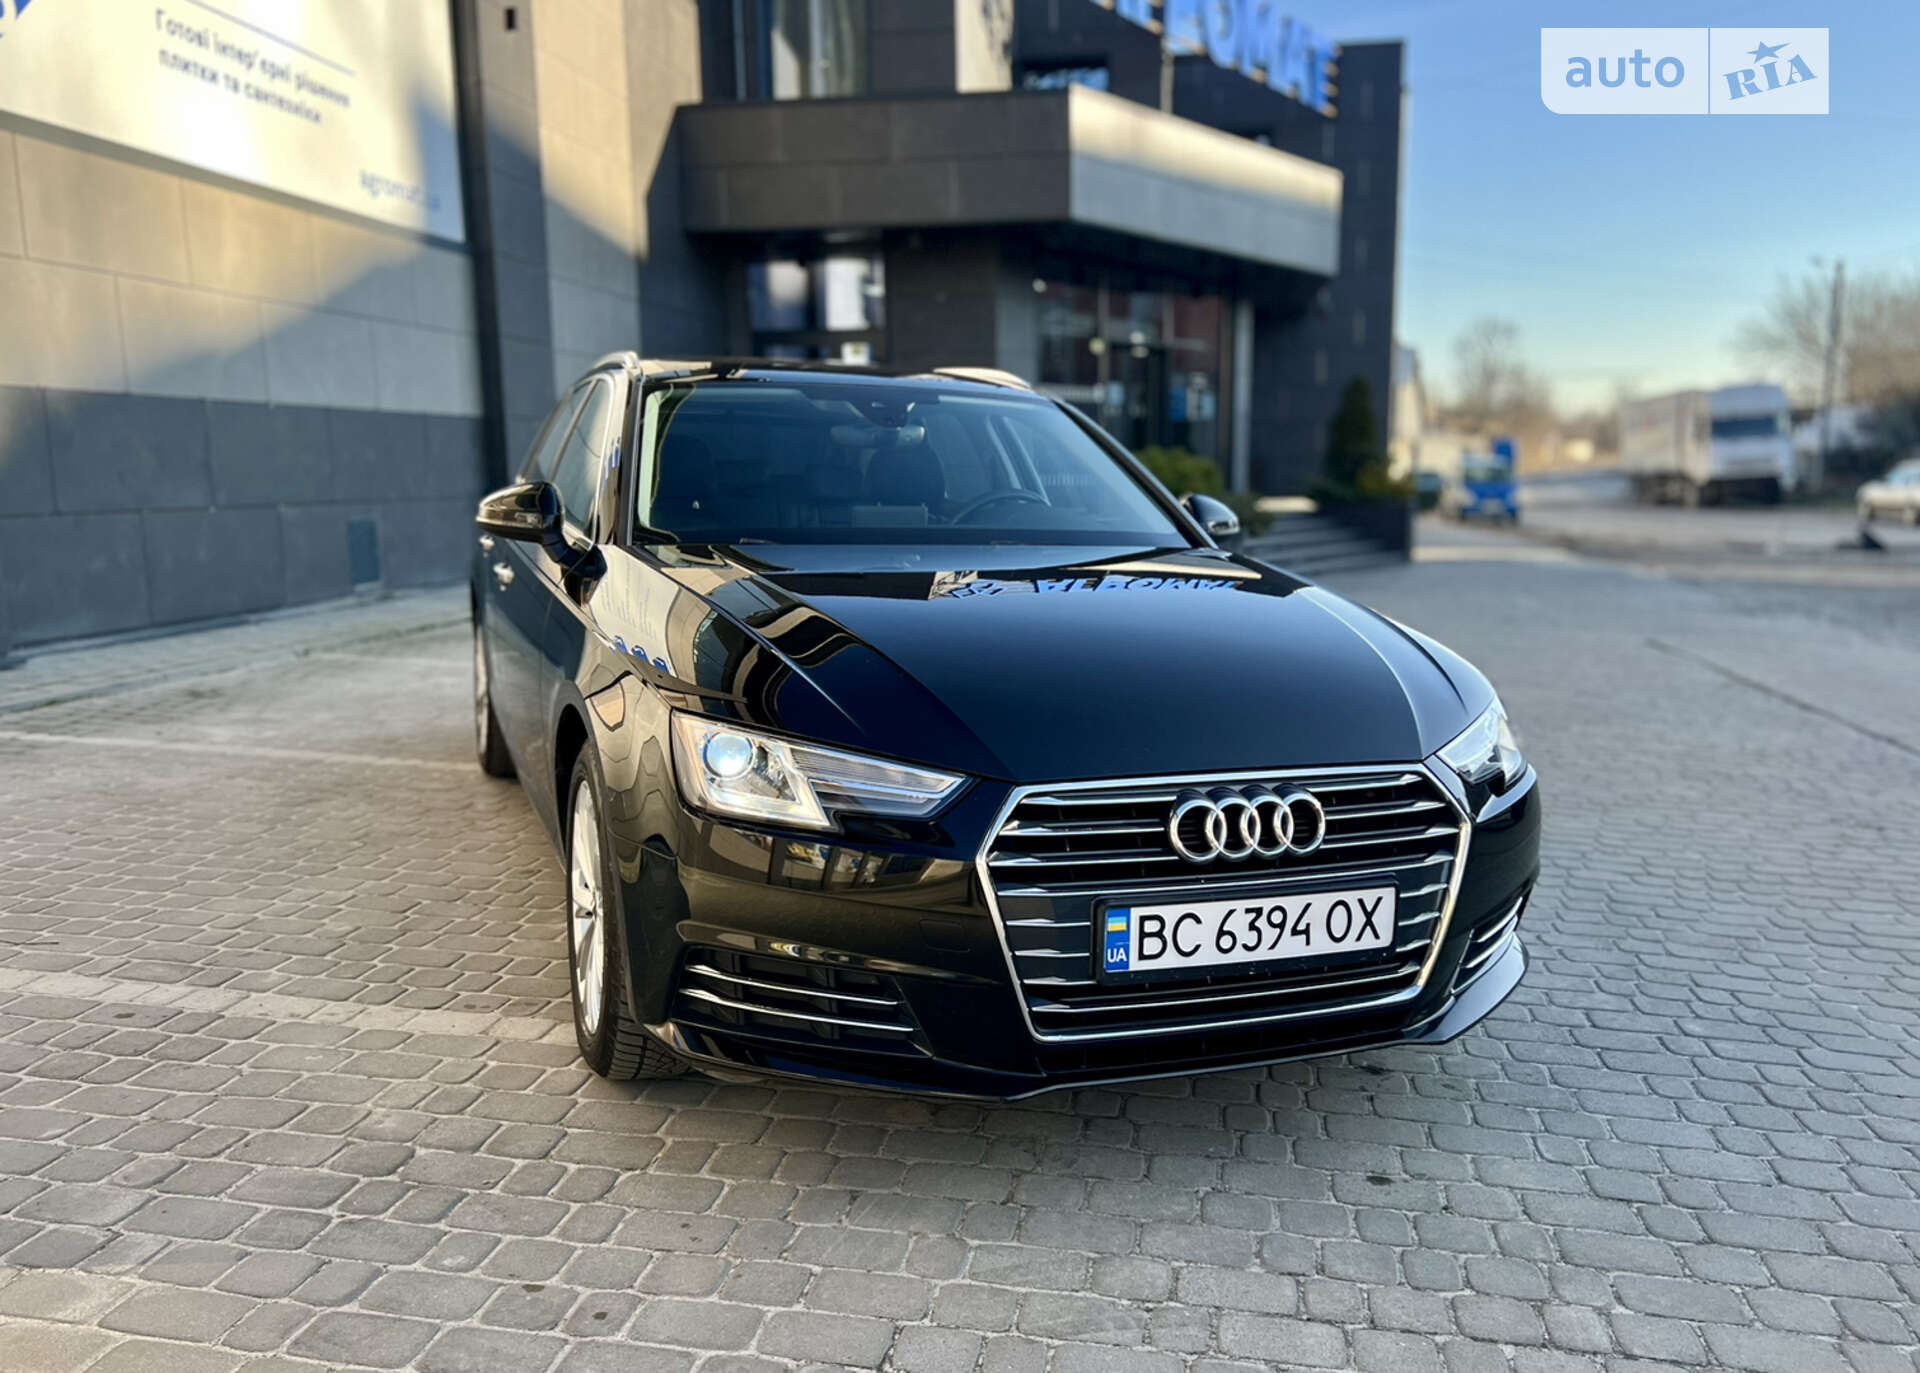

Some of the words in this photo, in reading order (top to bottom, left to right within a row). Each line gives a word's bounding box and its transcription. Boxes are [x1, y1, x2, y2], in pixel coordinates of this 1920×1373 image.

[1138, 912, 1203, 961] BC
[1215, 902, 1313, 954] 6394
[1325, 896, 1384, 943] OX
[1107, 948, 1128, 963] UA
